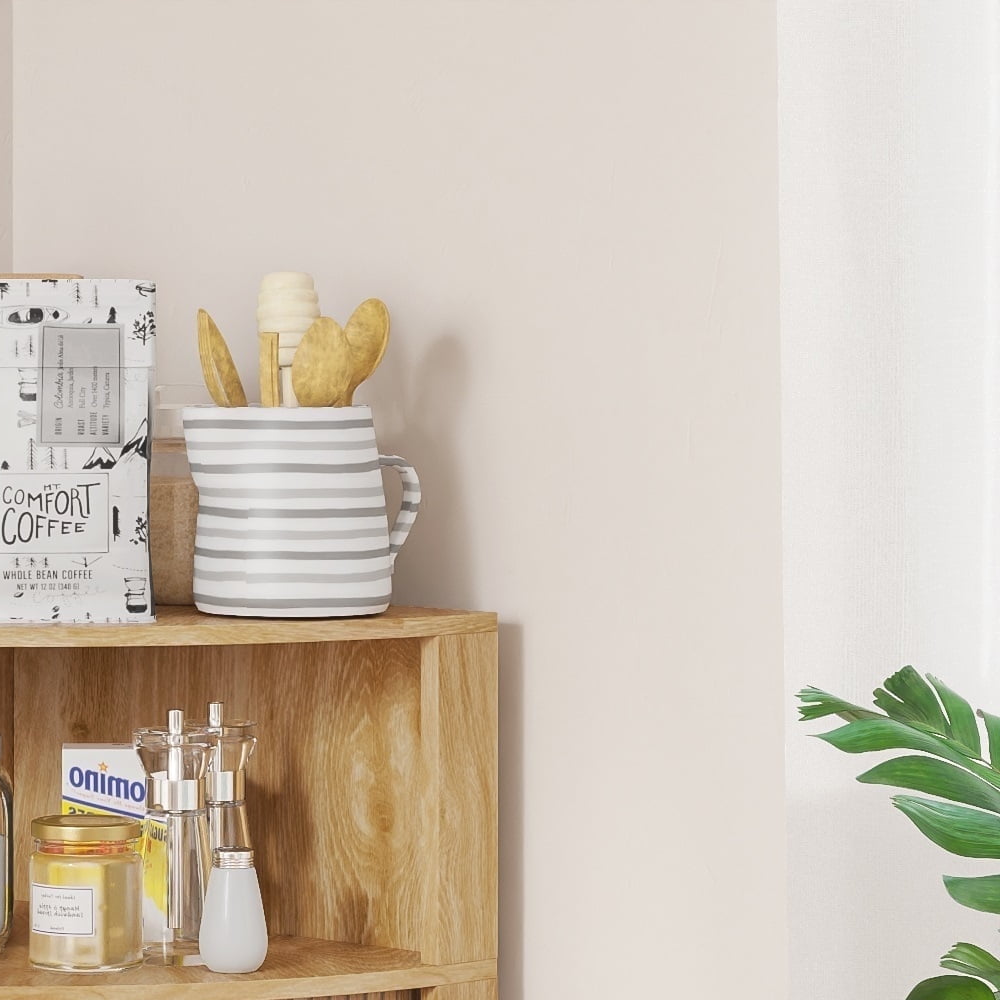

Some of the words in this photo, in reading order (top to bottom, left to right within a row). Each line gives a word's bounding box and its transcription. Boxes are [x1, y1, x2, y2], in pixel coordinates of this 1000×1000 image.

[2, 482, 101, 519] COMFORT
[1, 507, 87, 545] COFFEE
[3, 570, 33, 580] WHOLE
[36, 570, 59, 580] BEAN
[62, 569, 93, 580] COFFEE
[16, 583, 27, 591] NET
[30, 583, 39, 591] WT
